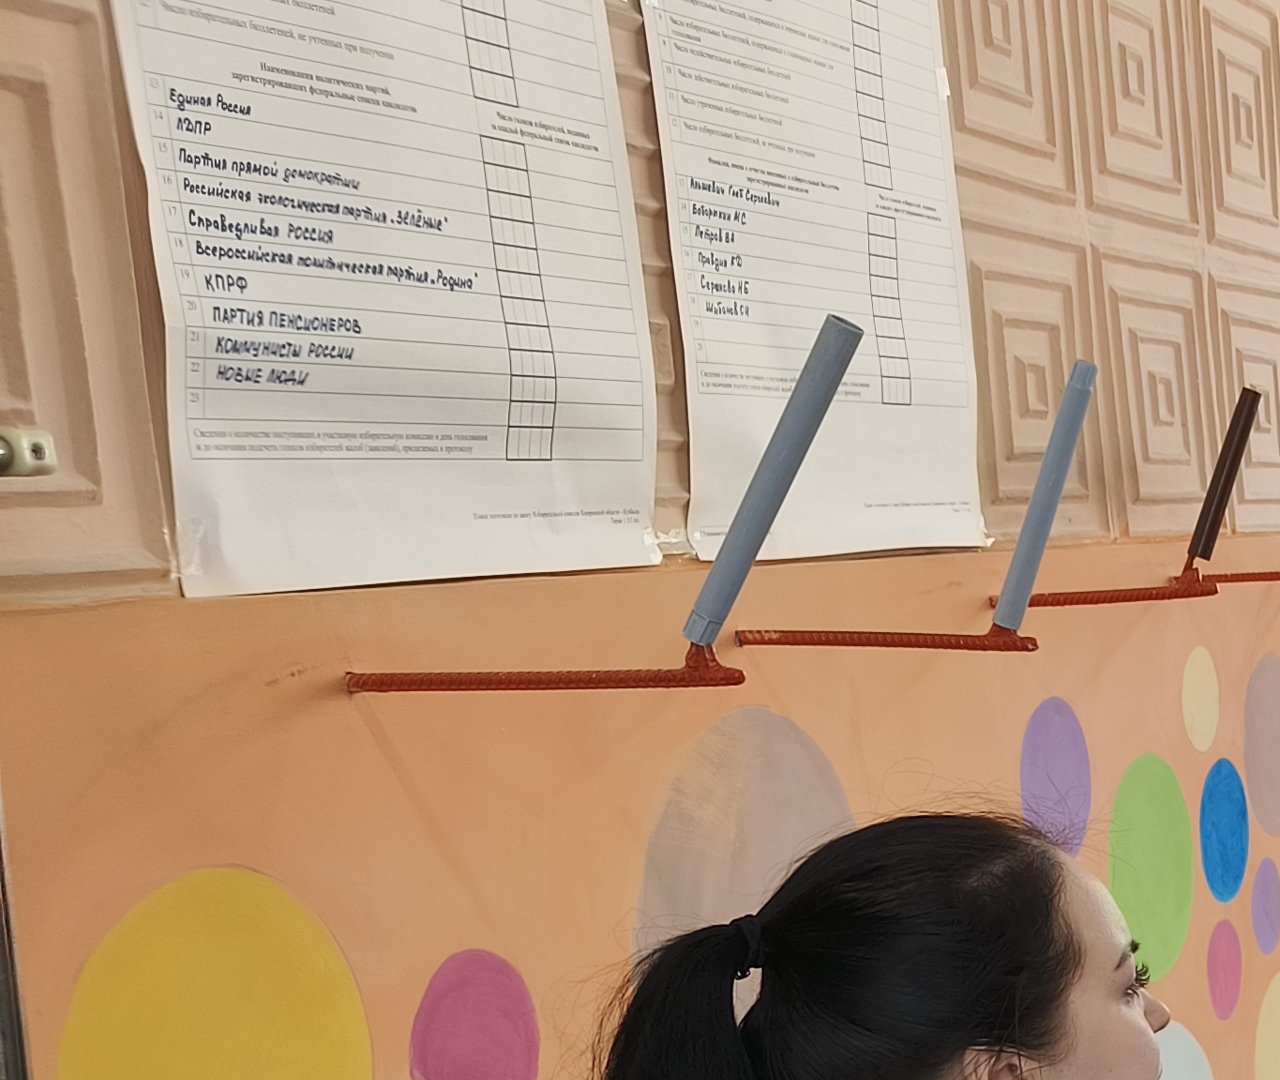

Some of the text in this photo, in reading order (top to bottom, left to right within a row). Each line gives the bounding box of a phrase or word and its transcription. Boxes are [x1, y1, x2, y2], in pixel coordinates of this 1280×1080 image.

[169, 87, 252, 116] Единая Россия
[176, 116, 212, 136] ЛДПР
[158, 142, 168, 152] 15
[178, 147, 361, 190] Партия прямой демократии
[162, 174, 173, 185] 16
[183, 177, 252, 203] Российская
[341, 205, 387, 224] партия
[167, 206, 177, 217] 17
[188, 208, 279, 240] Справедливая
[174, 237, 184, 248] 18
[195, 240, 293, 266] Всероссийская
[386, 265, 429, 284] партия
[180, 268, 190, 279] 19
[204, 273, 248, 294] КПРФ
[186, 300, 197, 311] 20
[212, 306, 362, 334] ПАРТИЯ ПЕНСИОНЕРОВ
[189, 331, 200, 342] 21
[190, 361, 200, 372] 22
[216, 364, 310, 386] НОВЫЕ ЛЮДИ
[189, 392, 200, 403] 23
